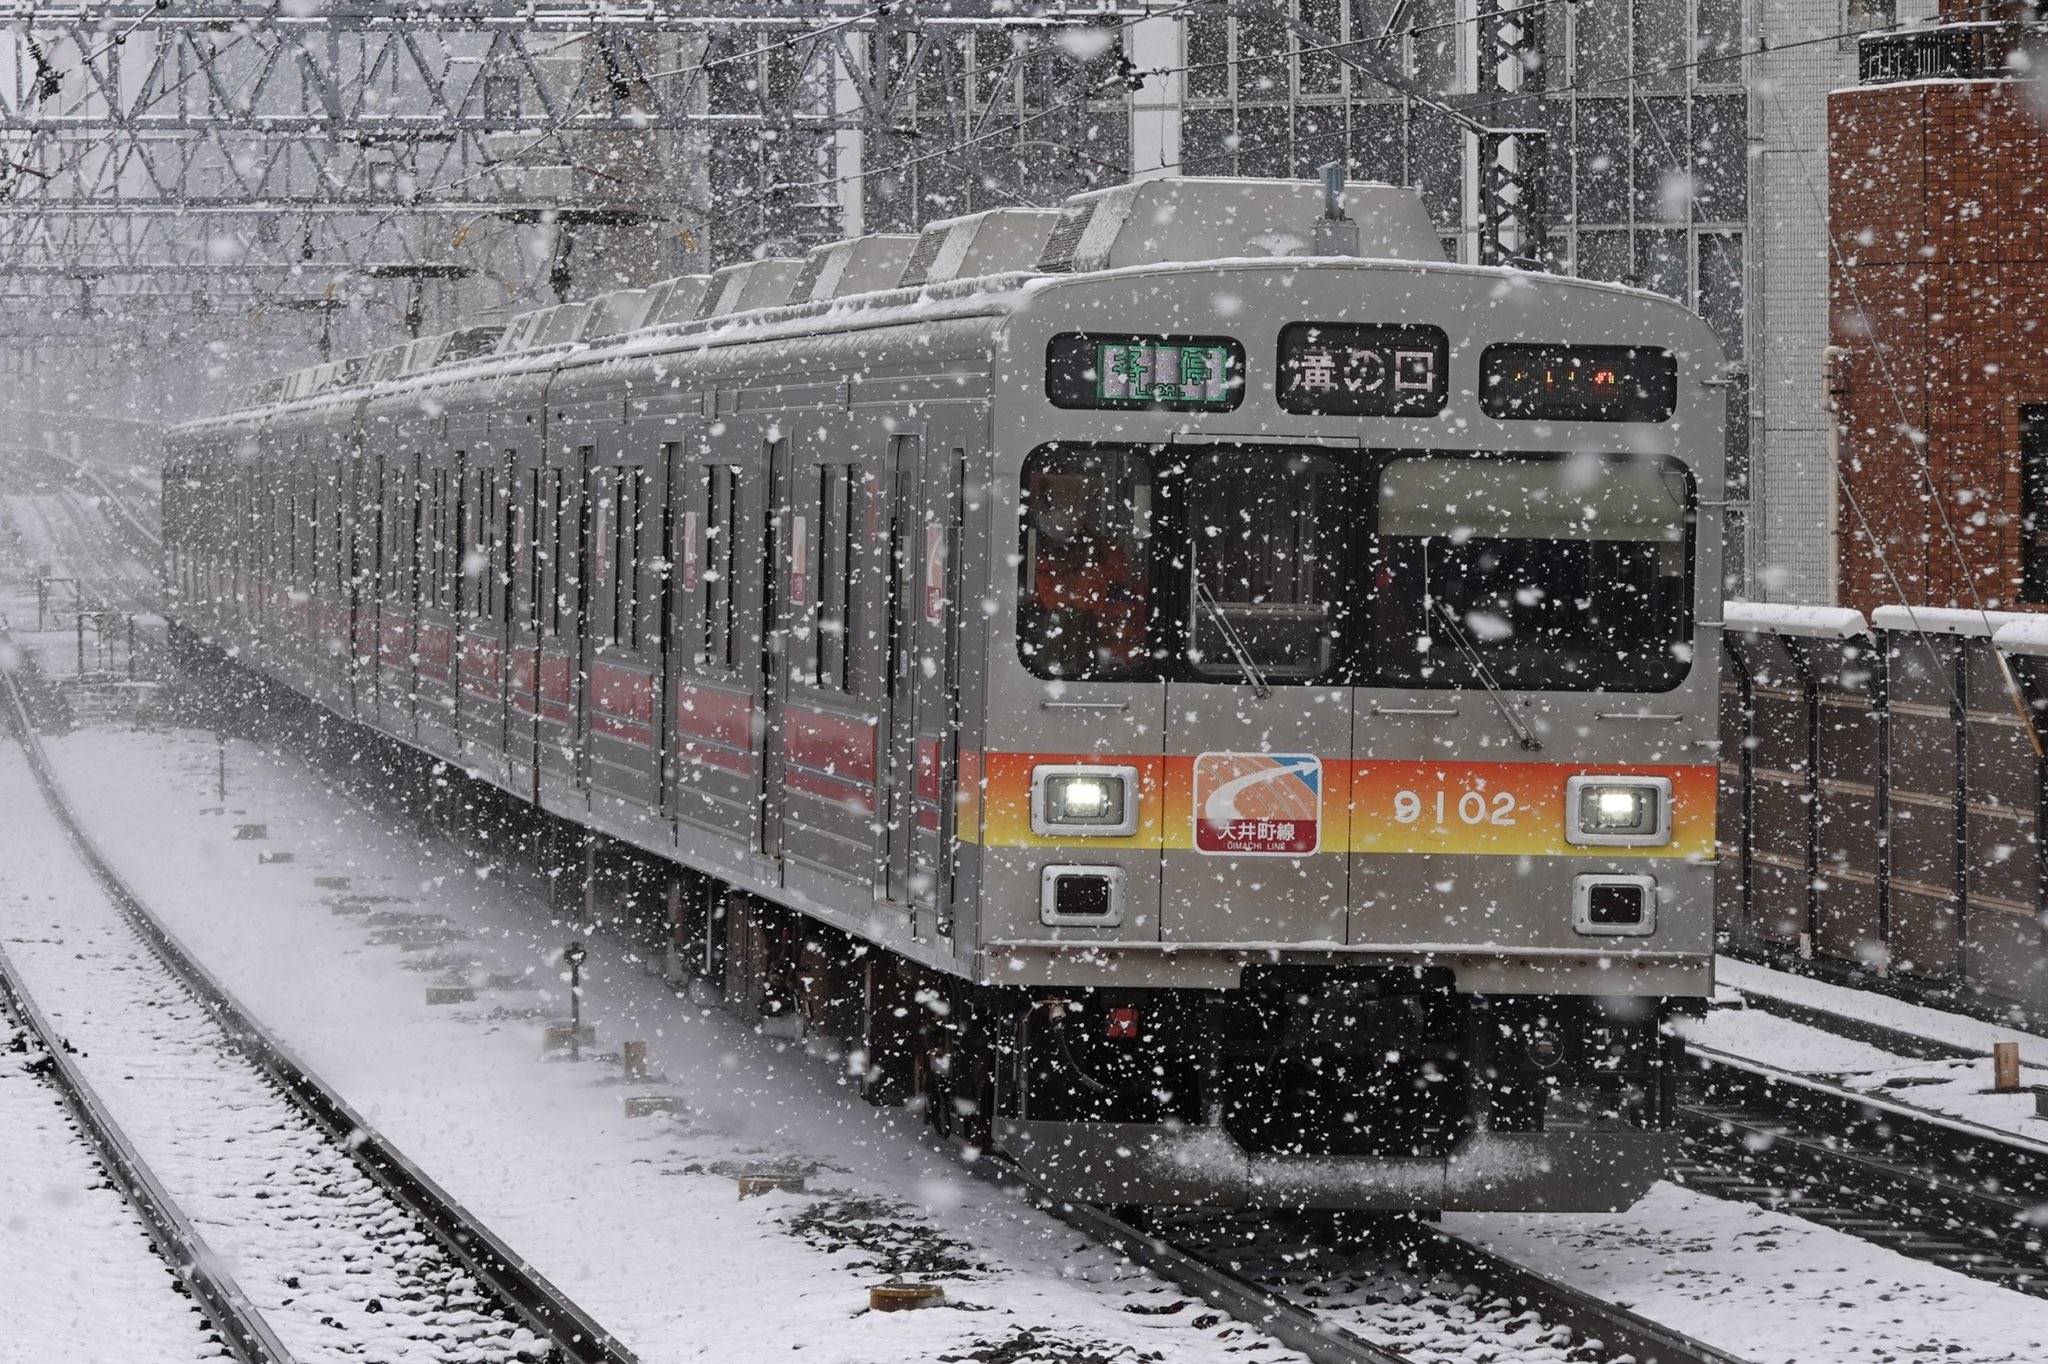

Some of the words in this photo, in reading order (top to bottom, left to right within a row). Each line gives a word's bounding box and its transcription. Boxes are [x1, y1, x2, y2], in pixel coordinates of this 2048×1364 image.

[1290, 347, 1434, 393] 溝の口
[1394, 790, 1516, 825] 9102
[1217, 822, 1295, 841] 大井町線
[1267, 842, 1286, 851] LINE
